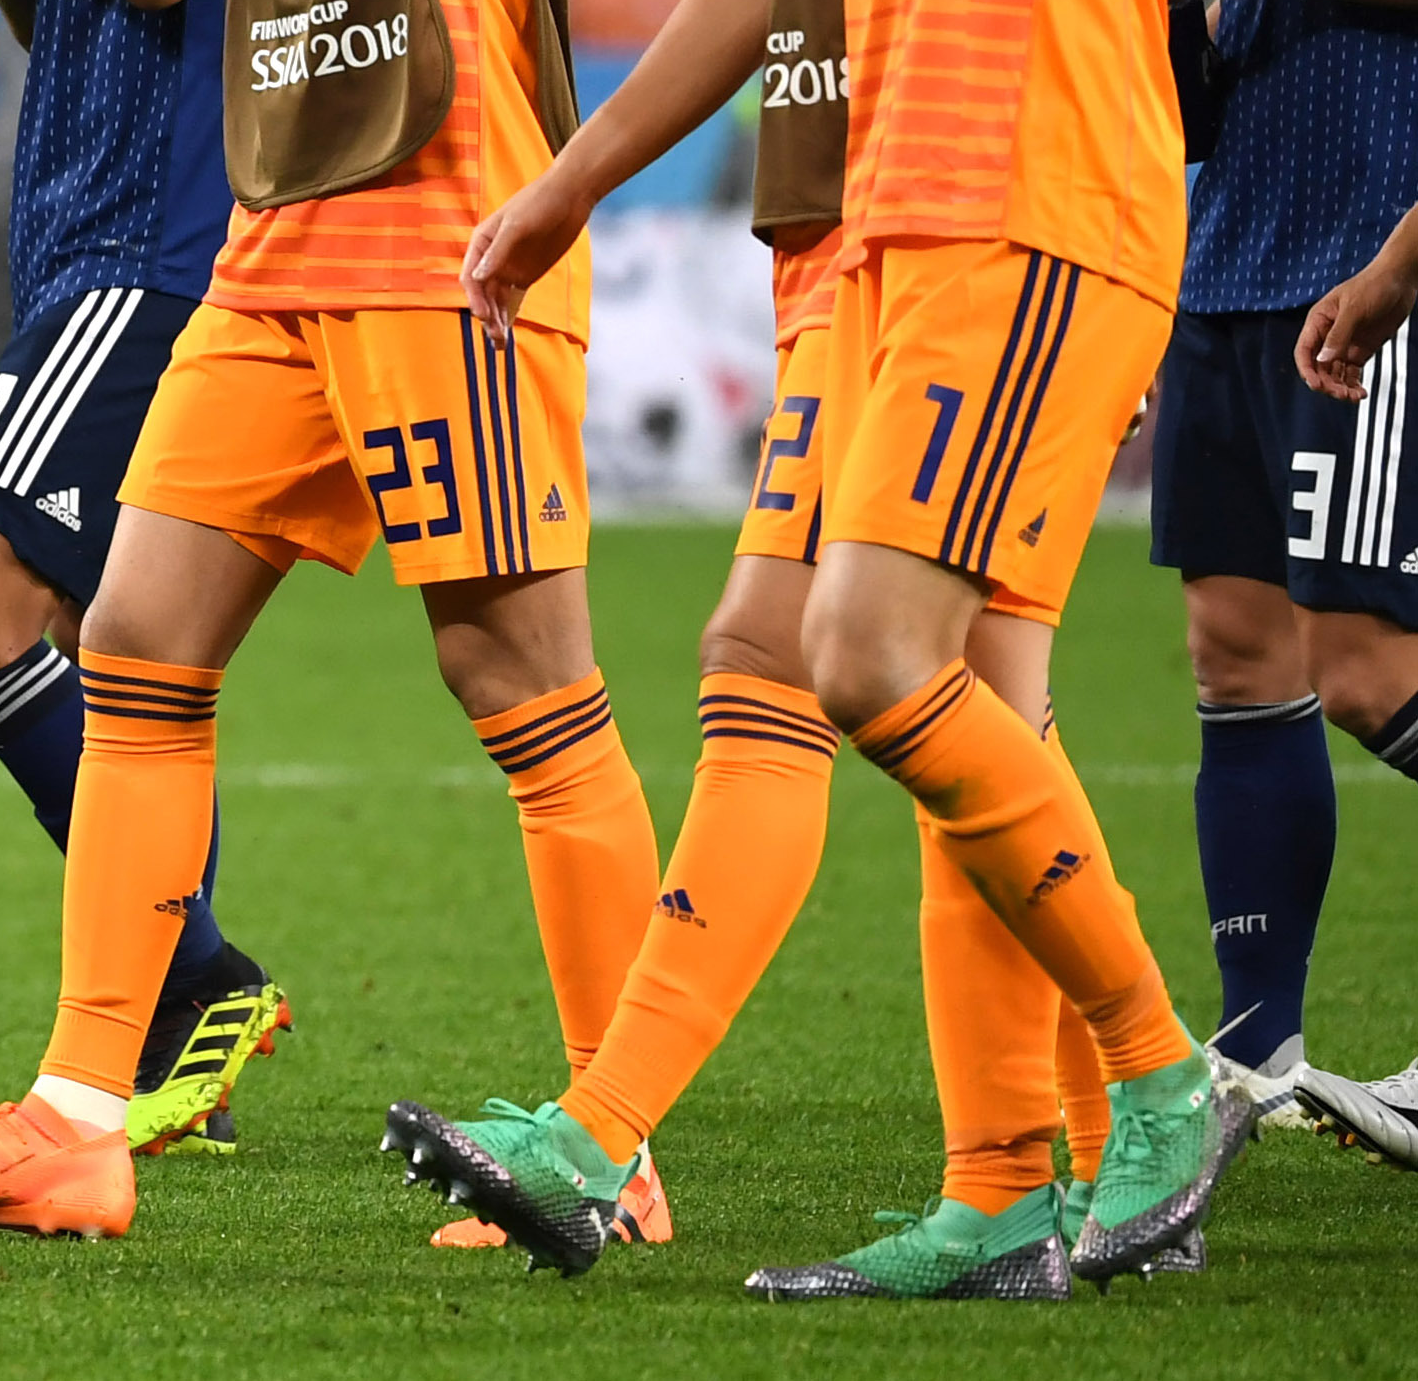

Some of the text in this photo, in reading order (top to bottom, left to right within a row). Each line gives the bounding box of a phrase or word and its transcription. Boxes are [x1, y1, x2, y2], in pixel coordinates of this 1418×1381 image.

[250, 0, 349, 41] FIFA WOR CUP
[310, 13, 408, 77] 2018
[766, 30, 805, 54] CUP
[755, 396, 821, 512] 2
[910, 383, 965, 505] 1
[363, 418, 462, 544] 23
[1288, 451, 1337, 560] 3
[35, 497, 83, 532] adidas
[1211, 914, 1267, 945] PAN
